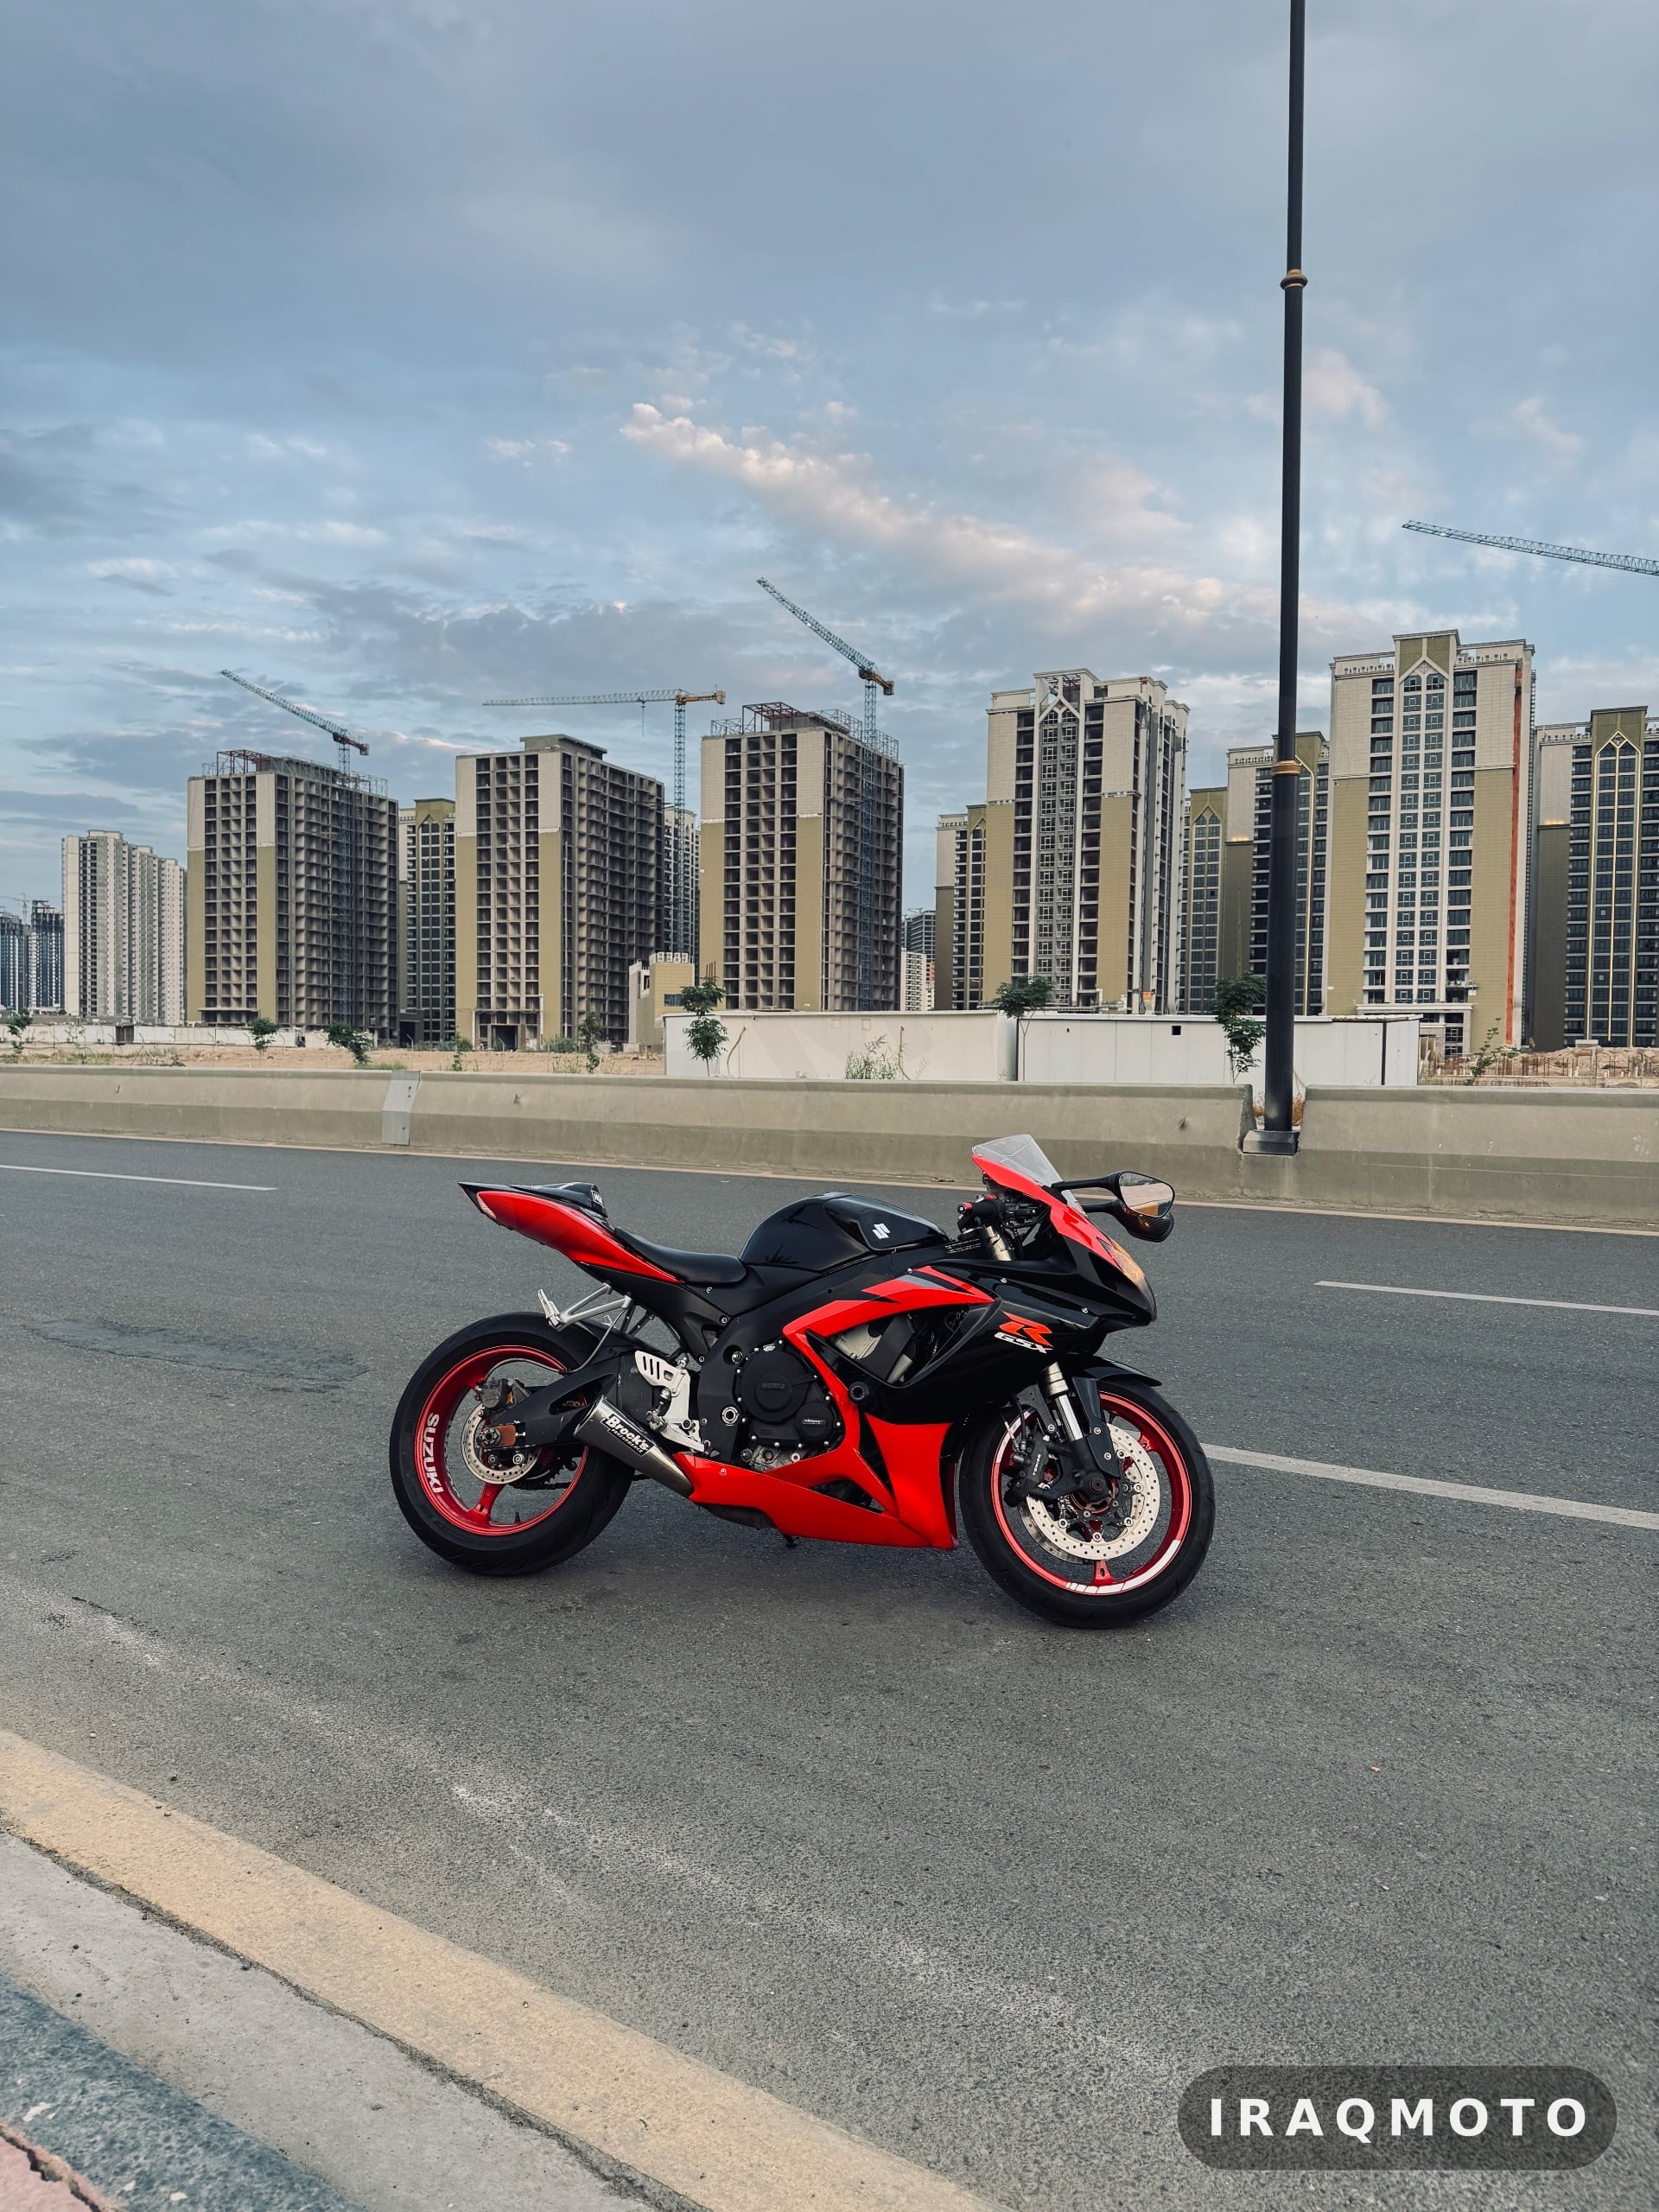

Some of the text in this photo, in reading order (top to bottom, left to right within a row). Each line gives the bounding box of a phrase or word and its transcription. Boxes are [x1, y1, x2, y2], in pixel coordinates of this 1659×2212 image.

[995, 1332, 1054, 1354] GSX
[999, 1311, 1054, 1347] R
[605, 1415, 650, 1451] Brock's
[423, 1412, 444, 1493] SUZUKI
